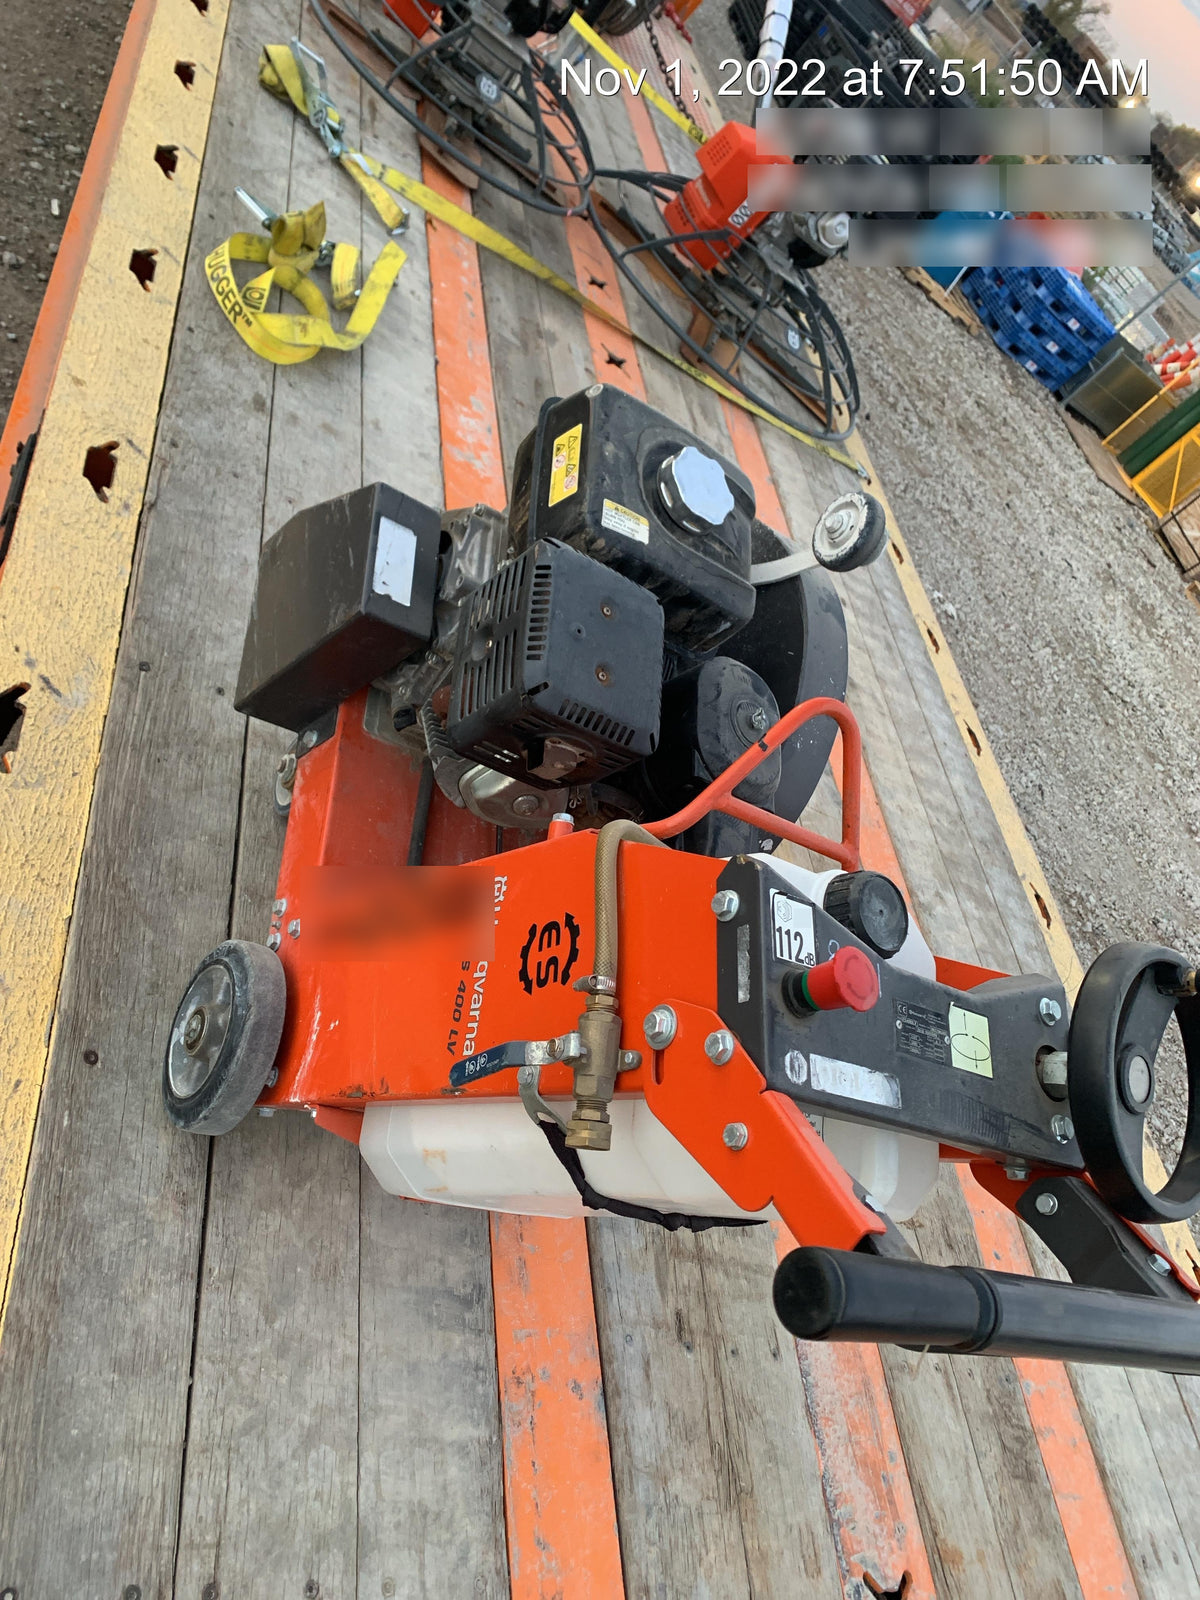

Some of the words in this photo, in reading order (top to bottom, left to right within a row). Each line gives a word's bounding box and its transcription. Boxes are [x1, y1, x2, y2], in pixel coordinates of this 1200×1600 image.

[775, 925, 805, 965] 112
[804, 951, 816, 967] dB
[452, 980, 467, 1023] 400
[446, 1028, 459, 1057] LV
